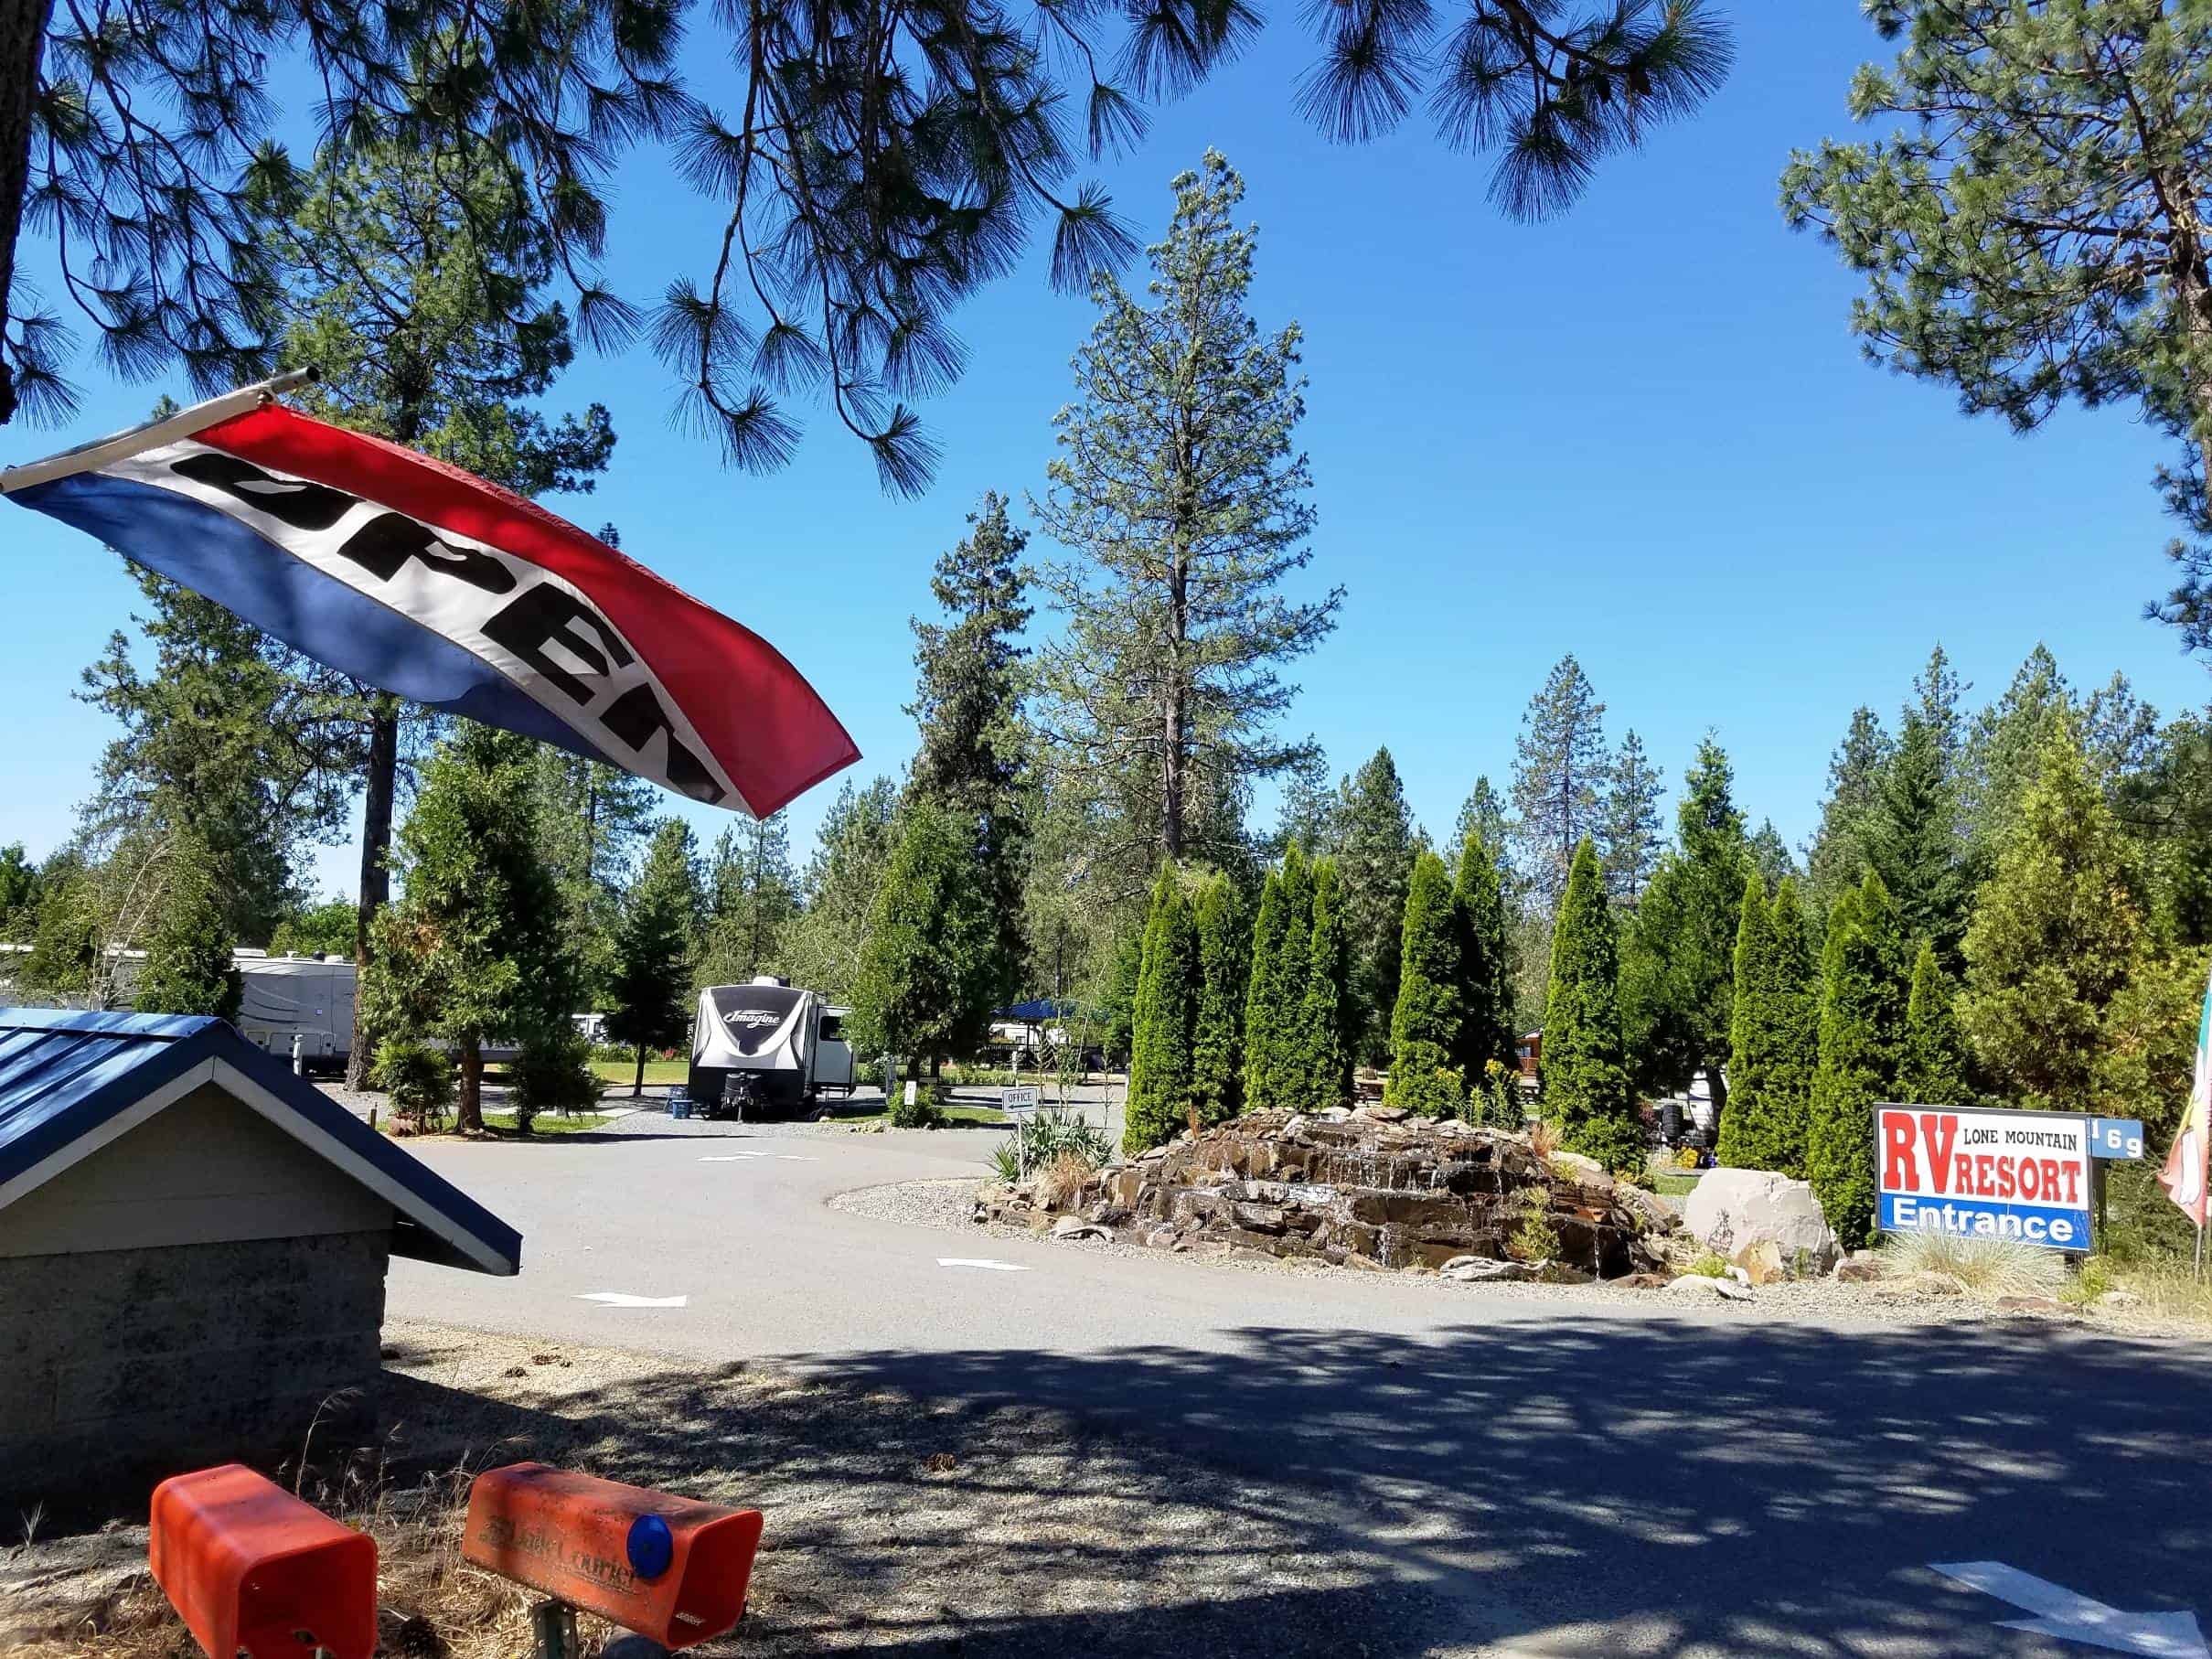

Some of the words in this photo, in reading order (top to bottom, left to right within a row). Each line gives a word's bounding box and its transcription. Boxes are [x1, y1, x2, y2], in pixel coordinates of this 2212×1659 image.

[723, 1010, 782, 1029] Imagine
[1008, 1092, 1032, 1103] OFFICE
[1964, 1128, 1998, 1145] LONE
[2005, 1129, 2078, 1151] MOUNTAIN
[1882, 1111, 1959, 1193] RV
[1955, 1152, 2081, 1204] RESORT
[1893, 1197, 2074, 1242] Entrance
